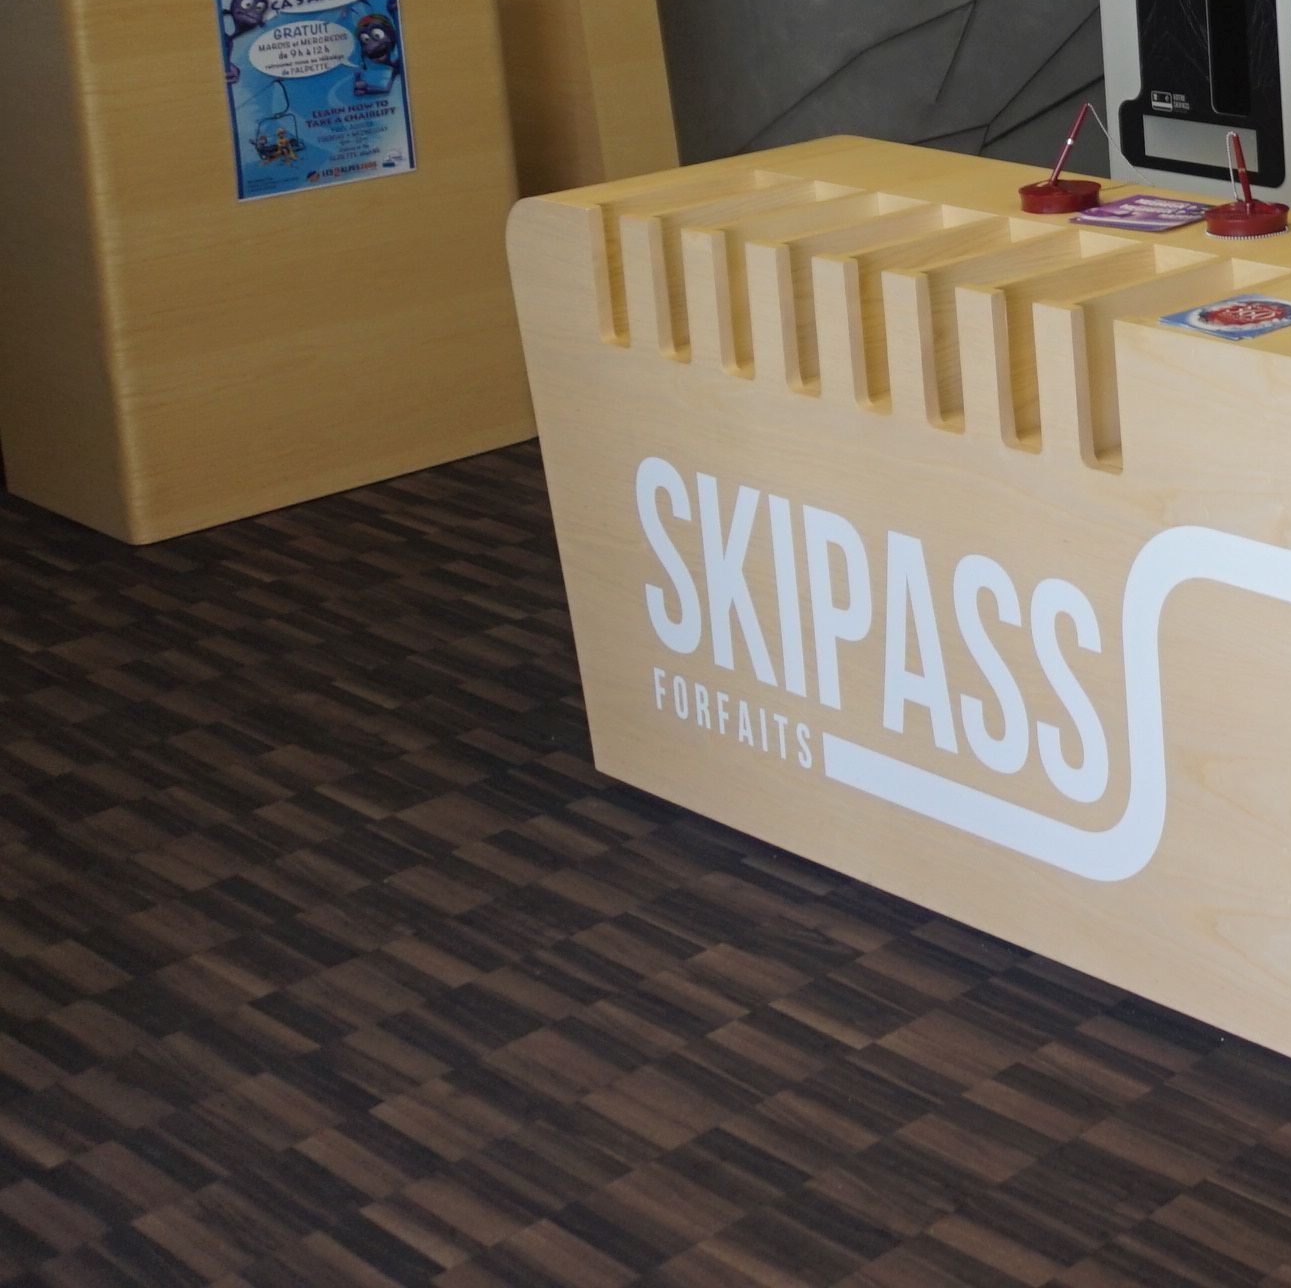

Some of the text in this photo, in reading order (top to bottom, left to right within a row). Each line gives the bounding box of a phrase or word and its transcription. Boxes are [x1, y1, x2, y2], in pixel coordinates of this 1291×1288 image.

[273, 22, 330, 40] GRATUIT
[636, 457, 1109, 803] SKIPASS
[653, 667, 814, 770] FORFAITS
